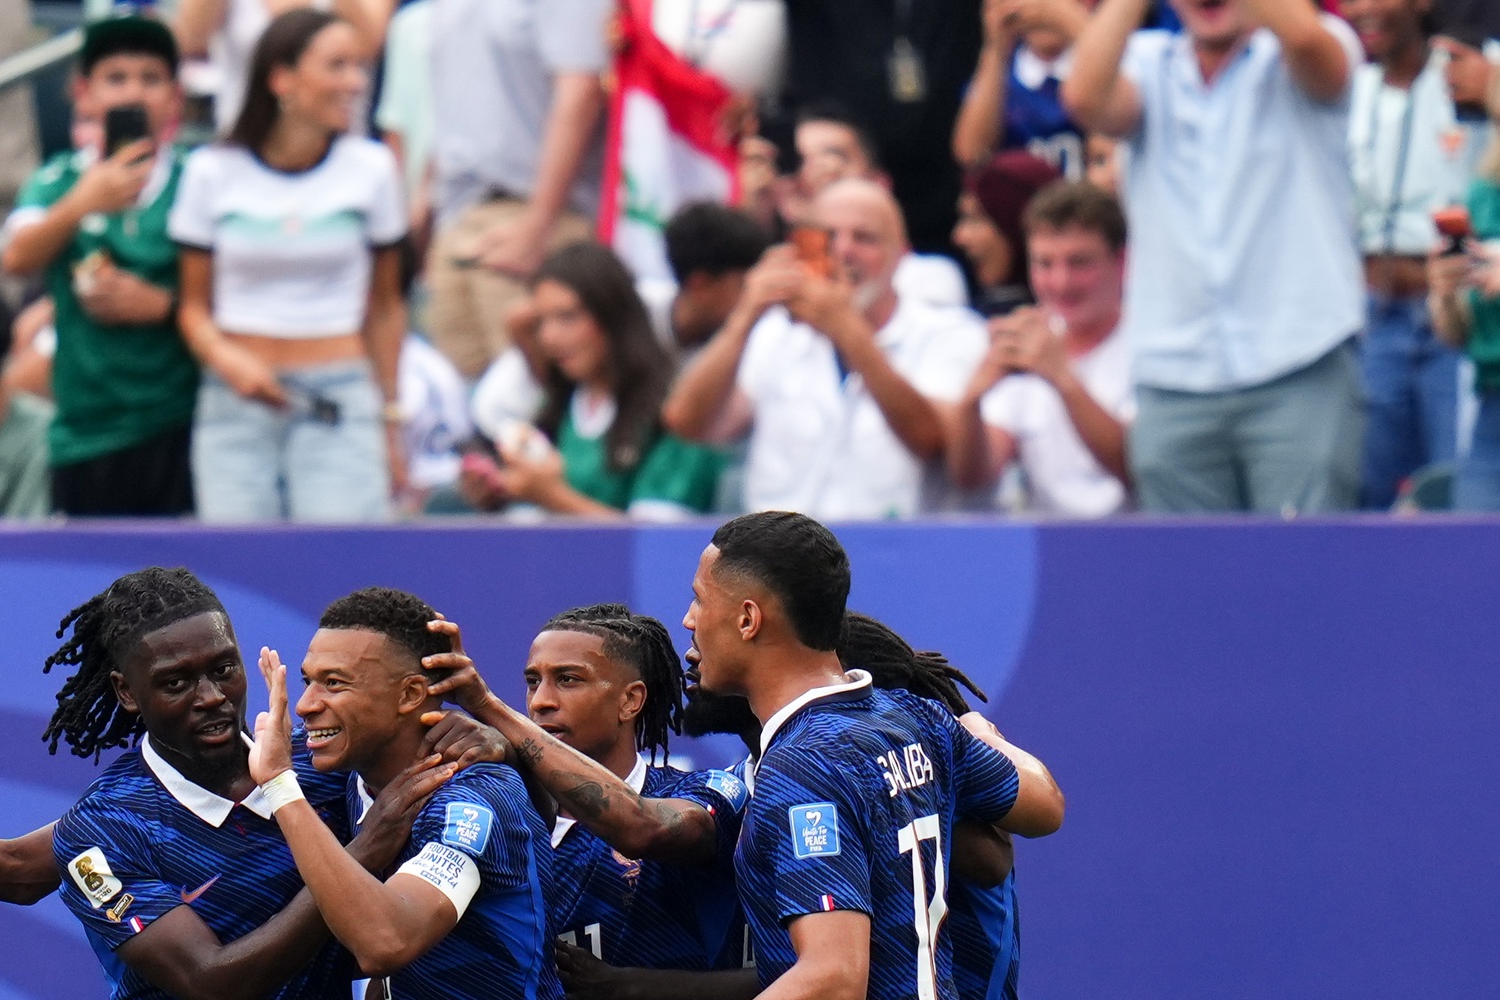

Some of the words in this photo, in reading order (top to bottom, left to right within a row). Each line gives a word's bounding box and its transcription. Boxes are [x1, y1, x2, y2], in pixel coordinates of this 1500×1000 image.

[877, 742, 933, 797] SALIBA
[456, 826, 479, 842] PEACE
[804, 835, 828, 847] PEACE
[420, 852, 461, 879] UNITES
[429, 843, 466, 870] FOOTBALL
[429, 864, 458, 889] World
[557, 922, 602, 960] 1
